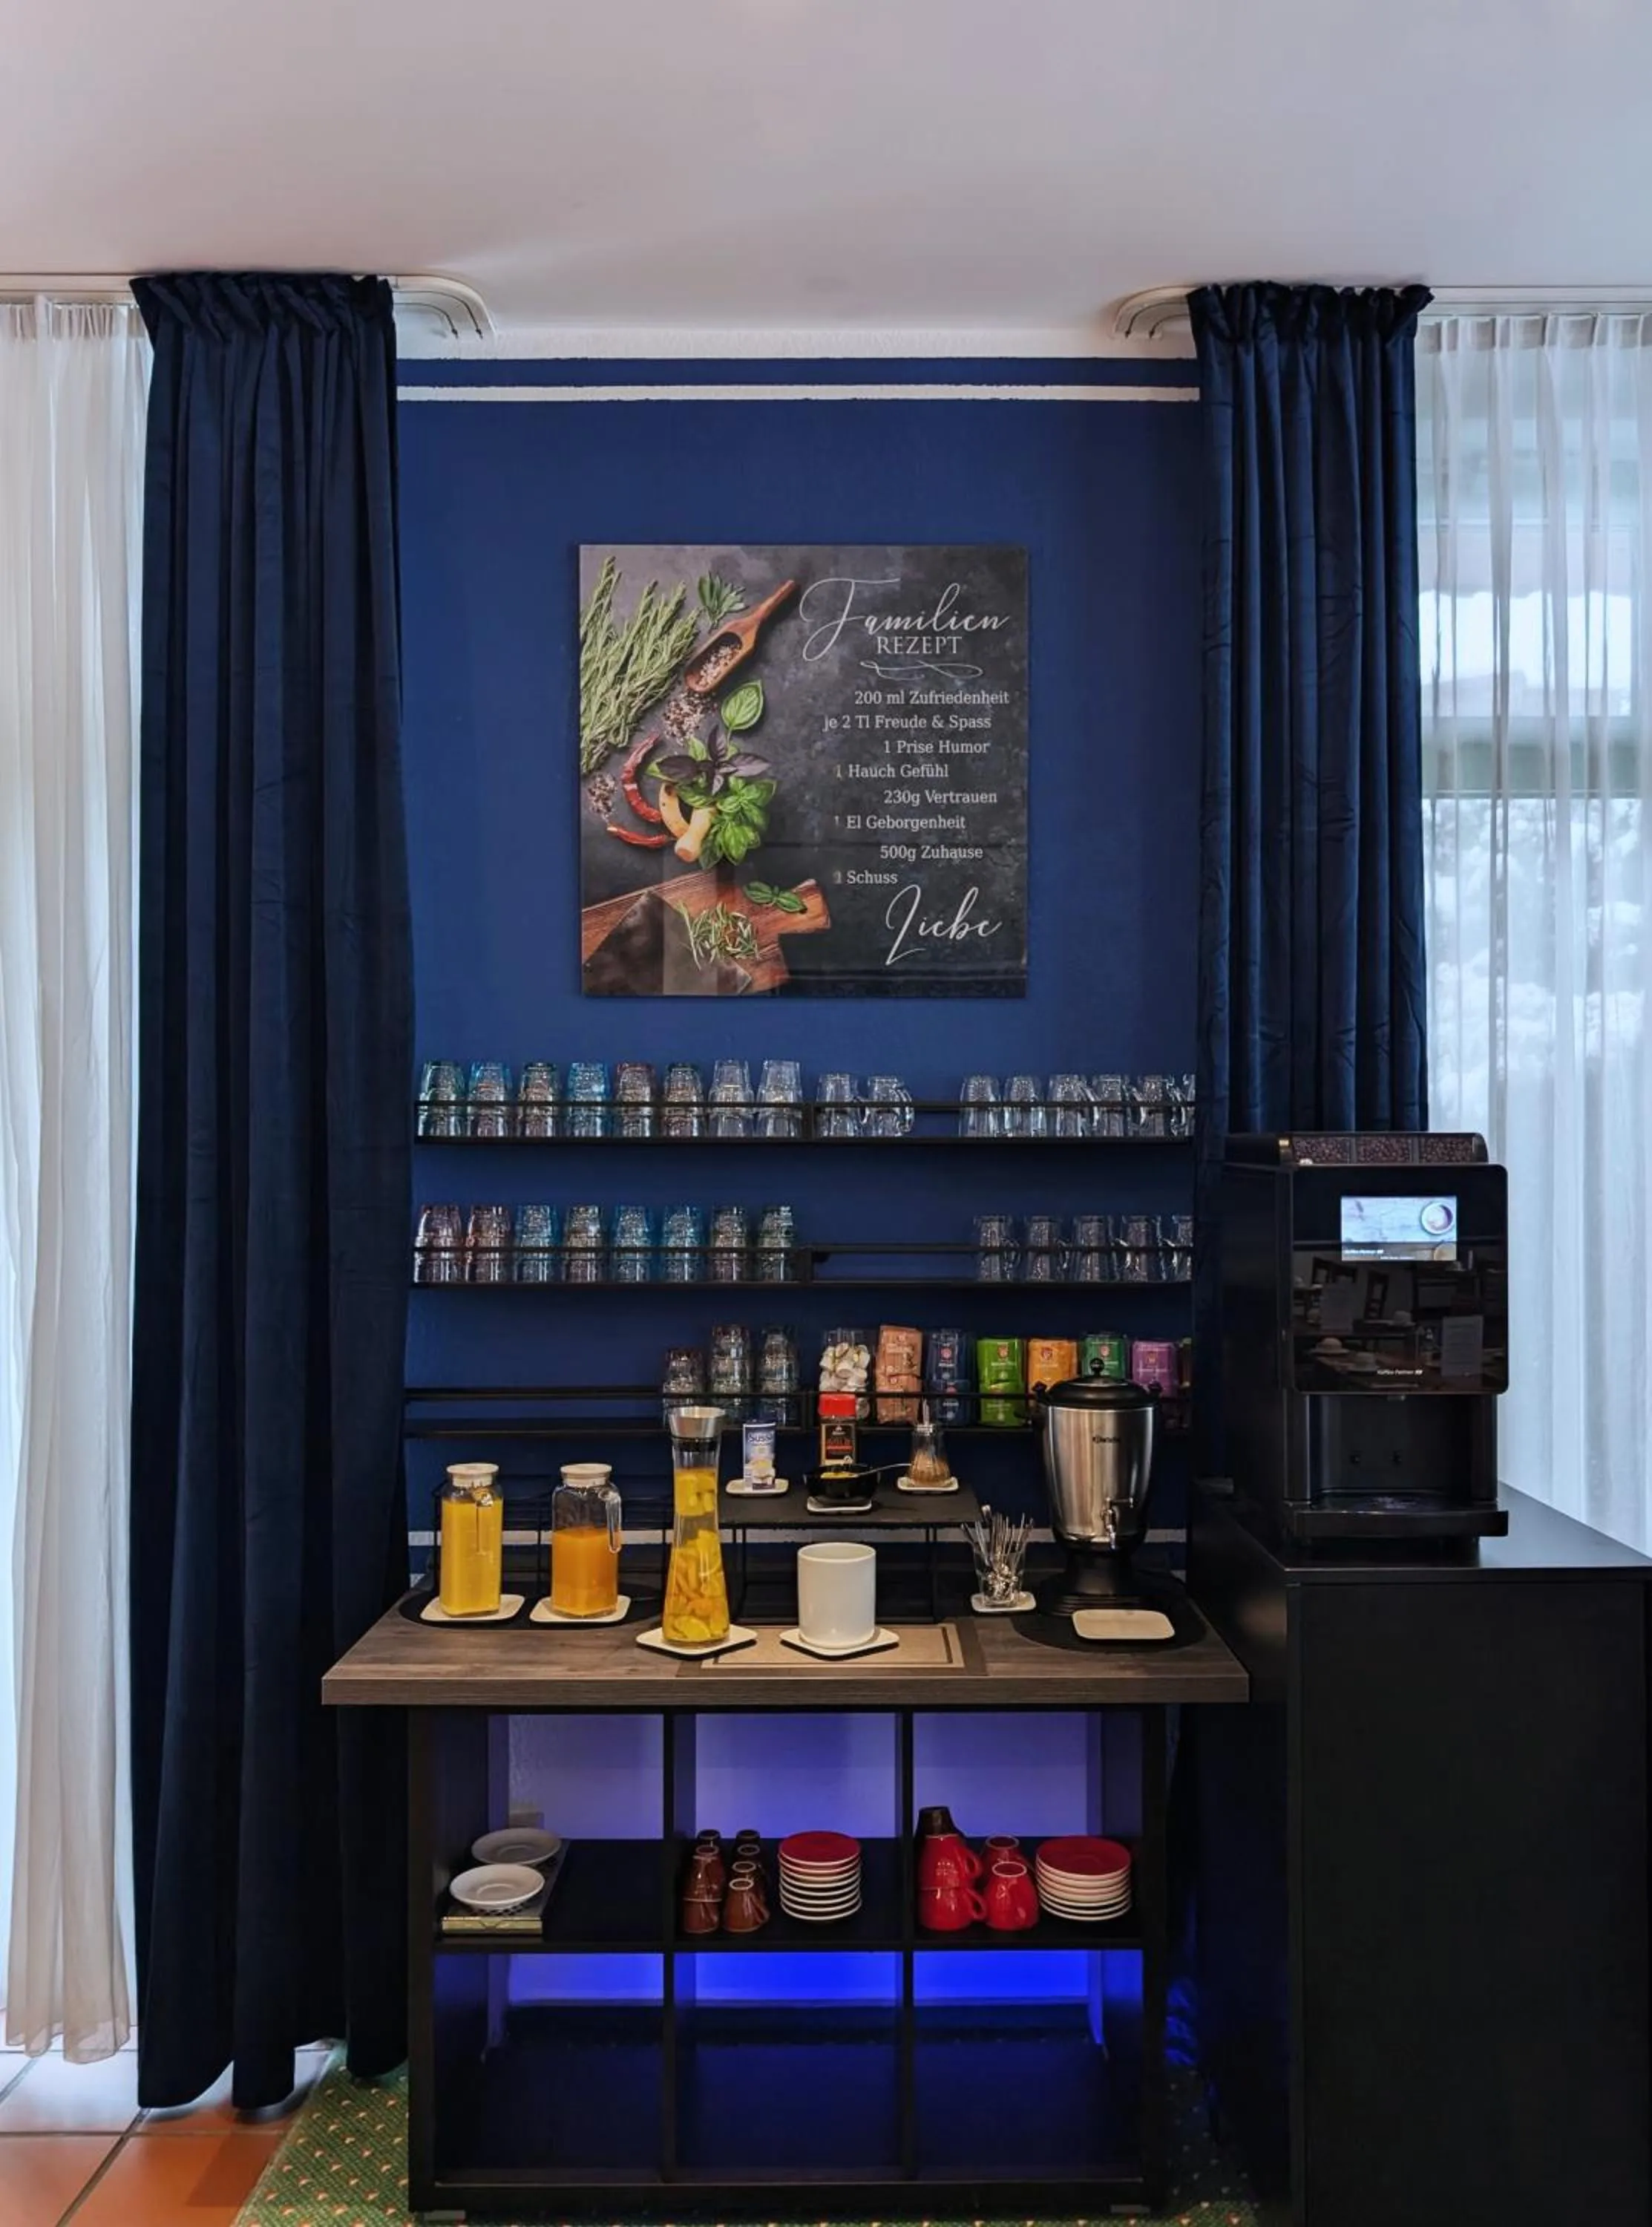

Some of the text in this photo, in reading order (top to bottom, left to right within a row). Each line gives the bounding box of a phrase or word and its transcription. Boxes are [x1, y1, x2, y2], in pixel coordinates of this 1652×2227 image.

[799, 578, 1010, 661] Familien
[877, 636, 962, 654] REZEPT
[854, 690, 1009, 705] 200 ml Zufriedenheit
[822, 716, 837, 732] je
[842, 716, 850, 728] 2
[875, 715, 928, 728] Freude
[931, 715, 944, 728] &
[949, 715, 991, 731] Spass
[884, 740, 990, 753] 1 Prise Humor
[848, 764, 895, 777] Hauch
[900, 764, 948, 777] Gefühl
[925, 789, 997, 804] Vertrauen
[866, 815, 966, 831] Geborgenheit
[880, 845, 983, 861] 500g Zuhause
[847, 869, 898, 884] Schuss
[885, 884, 1003, 966] Liebe
